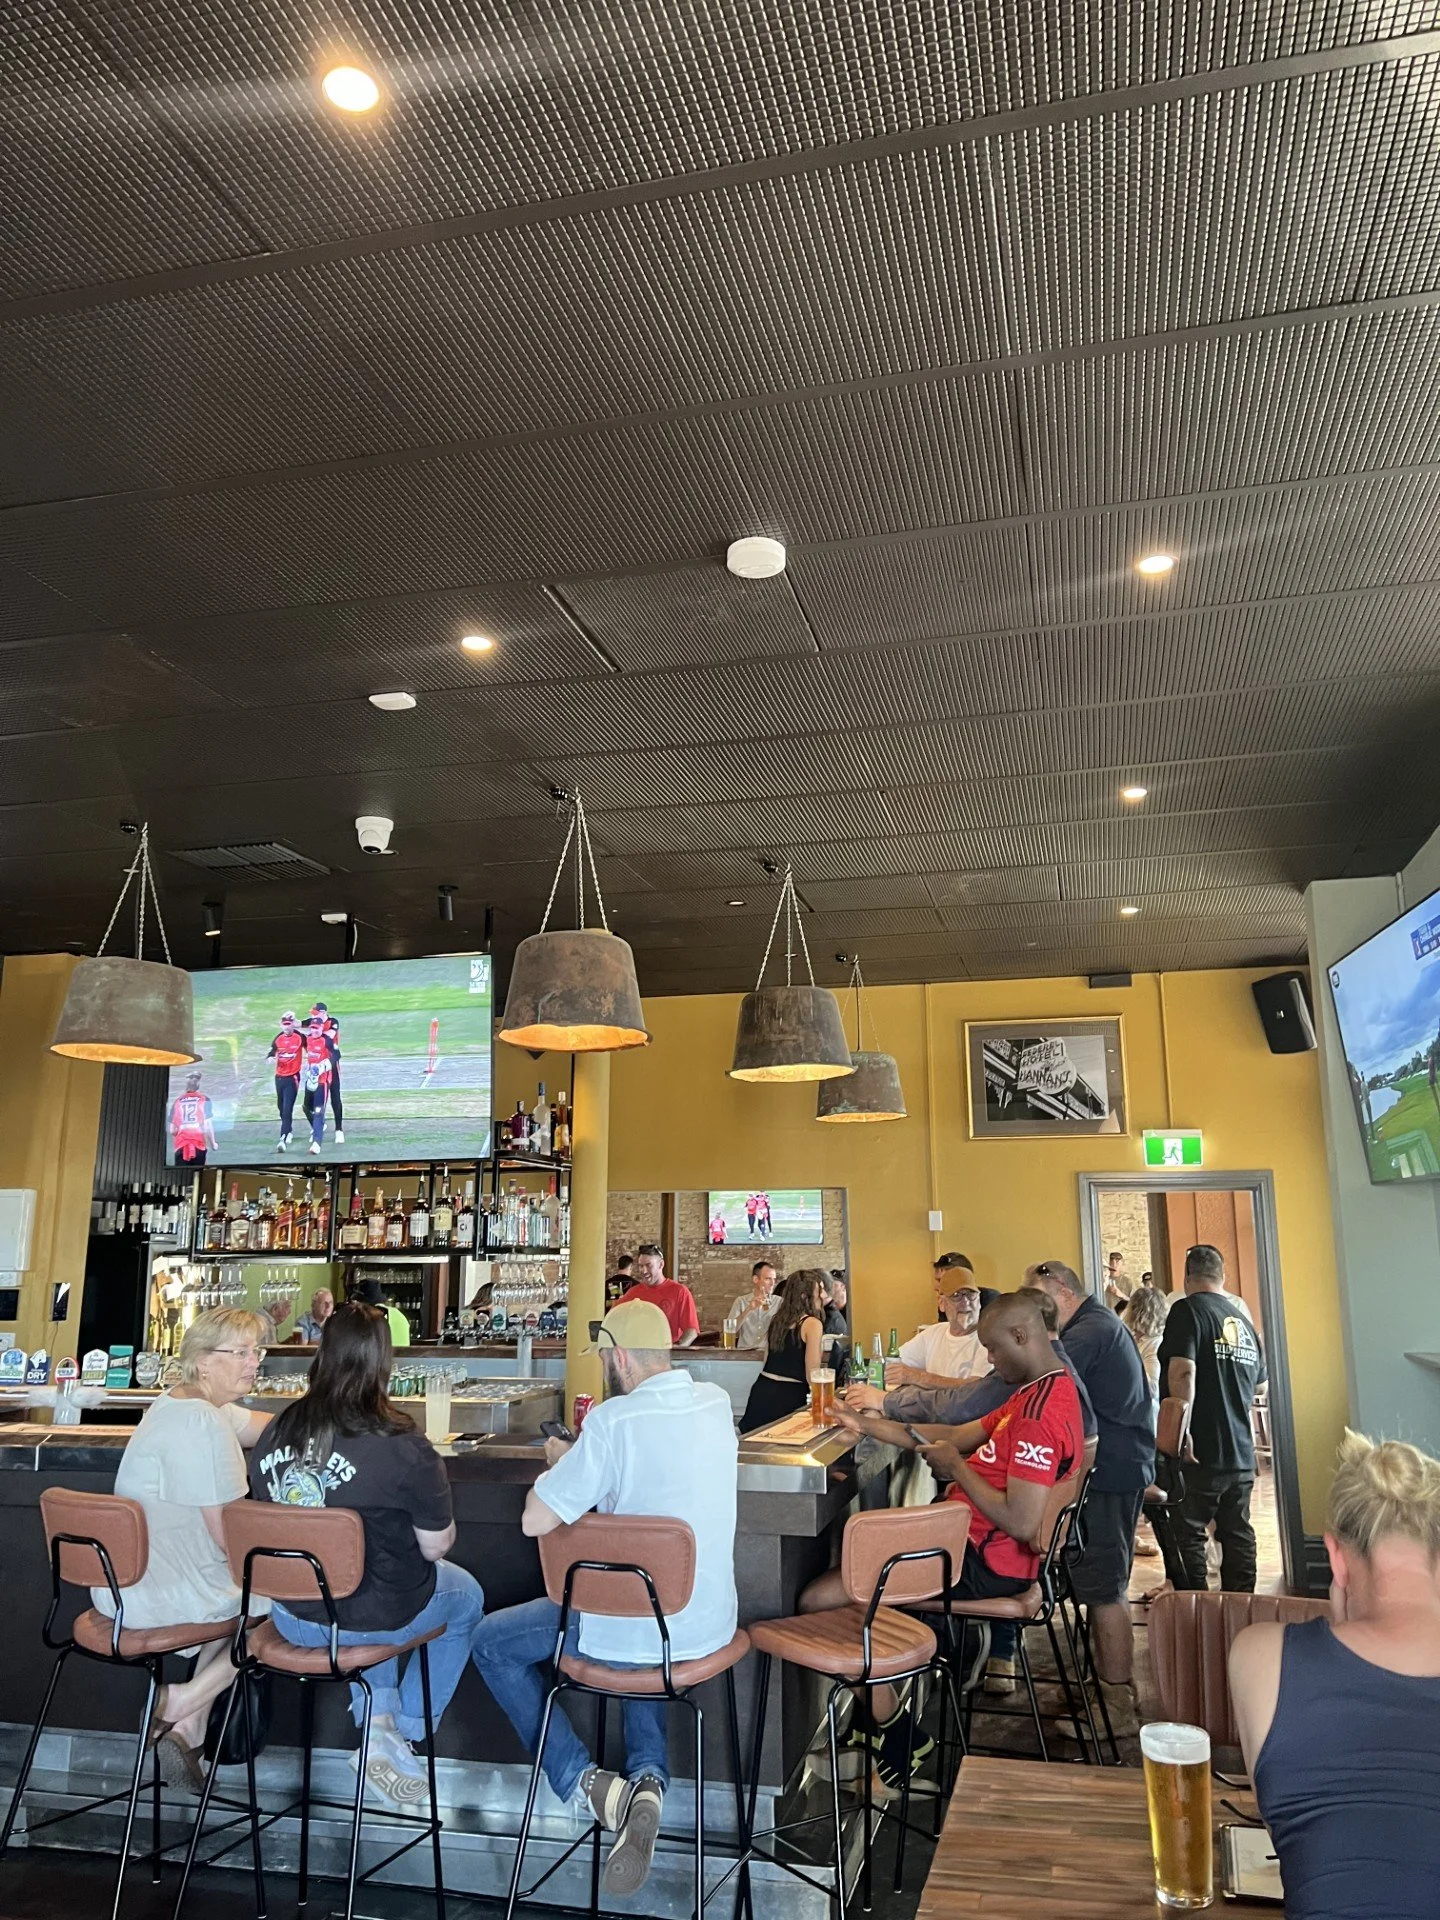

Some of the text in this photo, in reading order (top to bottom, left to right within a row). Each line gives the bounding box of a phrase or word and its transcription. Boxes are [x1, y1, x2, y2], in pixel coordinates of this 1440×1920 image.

[1022, 1050, 1061, 1067] HOTEL
[182, 1103, 196, 1121] 12
[1015, 1441, 1054, 1465] DXC
[1015, 1457, 1051, 1471] TECHNOLOGY
